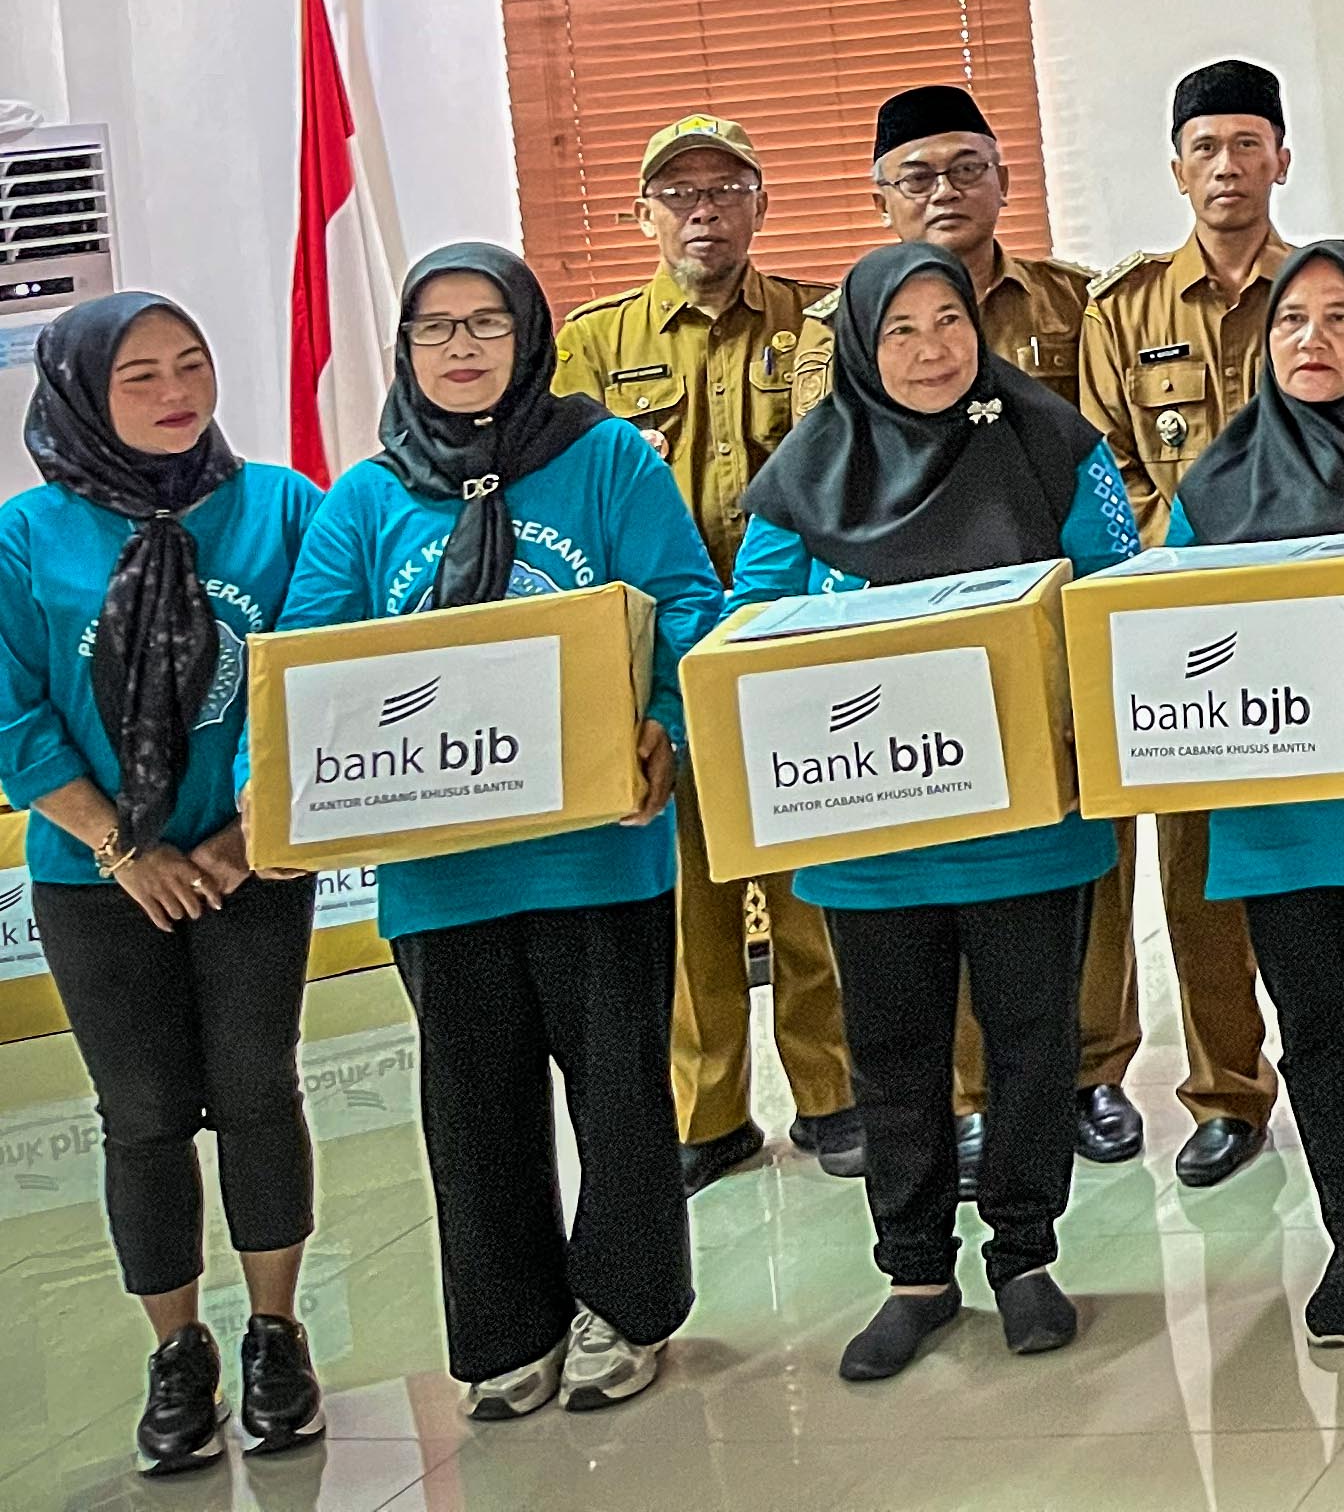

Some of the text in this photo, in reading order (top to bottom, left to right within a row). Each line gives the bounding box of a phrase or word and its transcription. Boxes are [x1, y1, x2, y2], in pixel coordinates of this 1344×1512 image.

[387, 560, 423, 614] PKK
[1131, 687, 1311, 734] bank bjb
[315, 726, 520, 784] bank bjb
[772, 732, 964, 788] bank bjb
[1131, 742, 1316, 758] KANTOR CABANG KHUSUS BANTEN
[773, 781, 972, 814] KANTOR CABANG KHUSUS BANTEN
